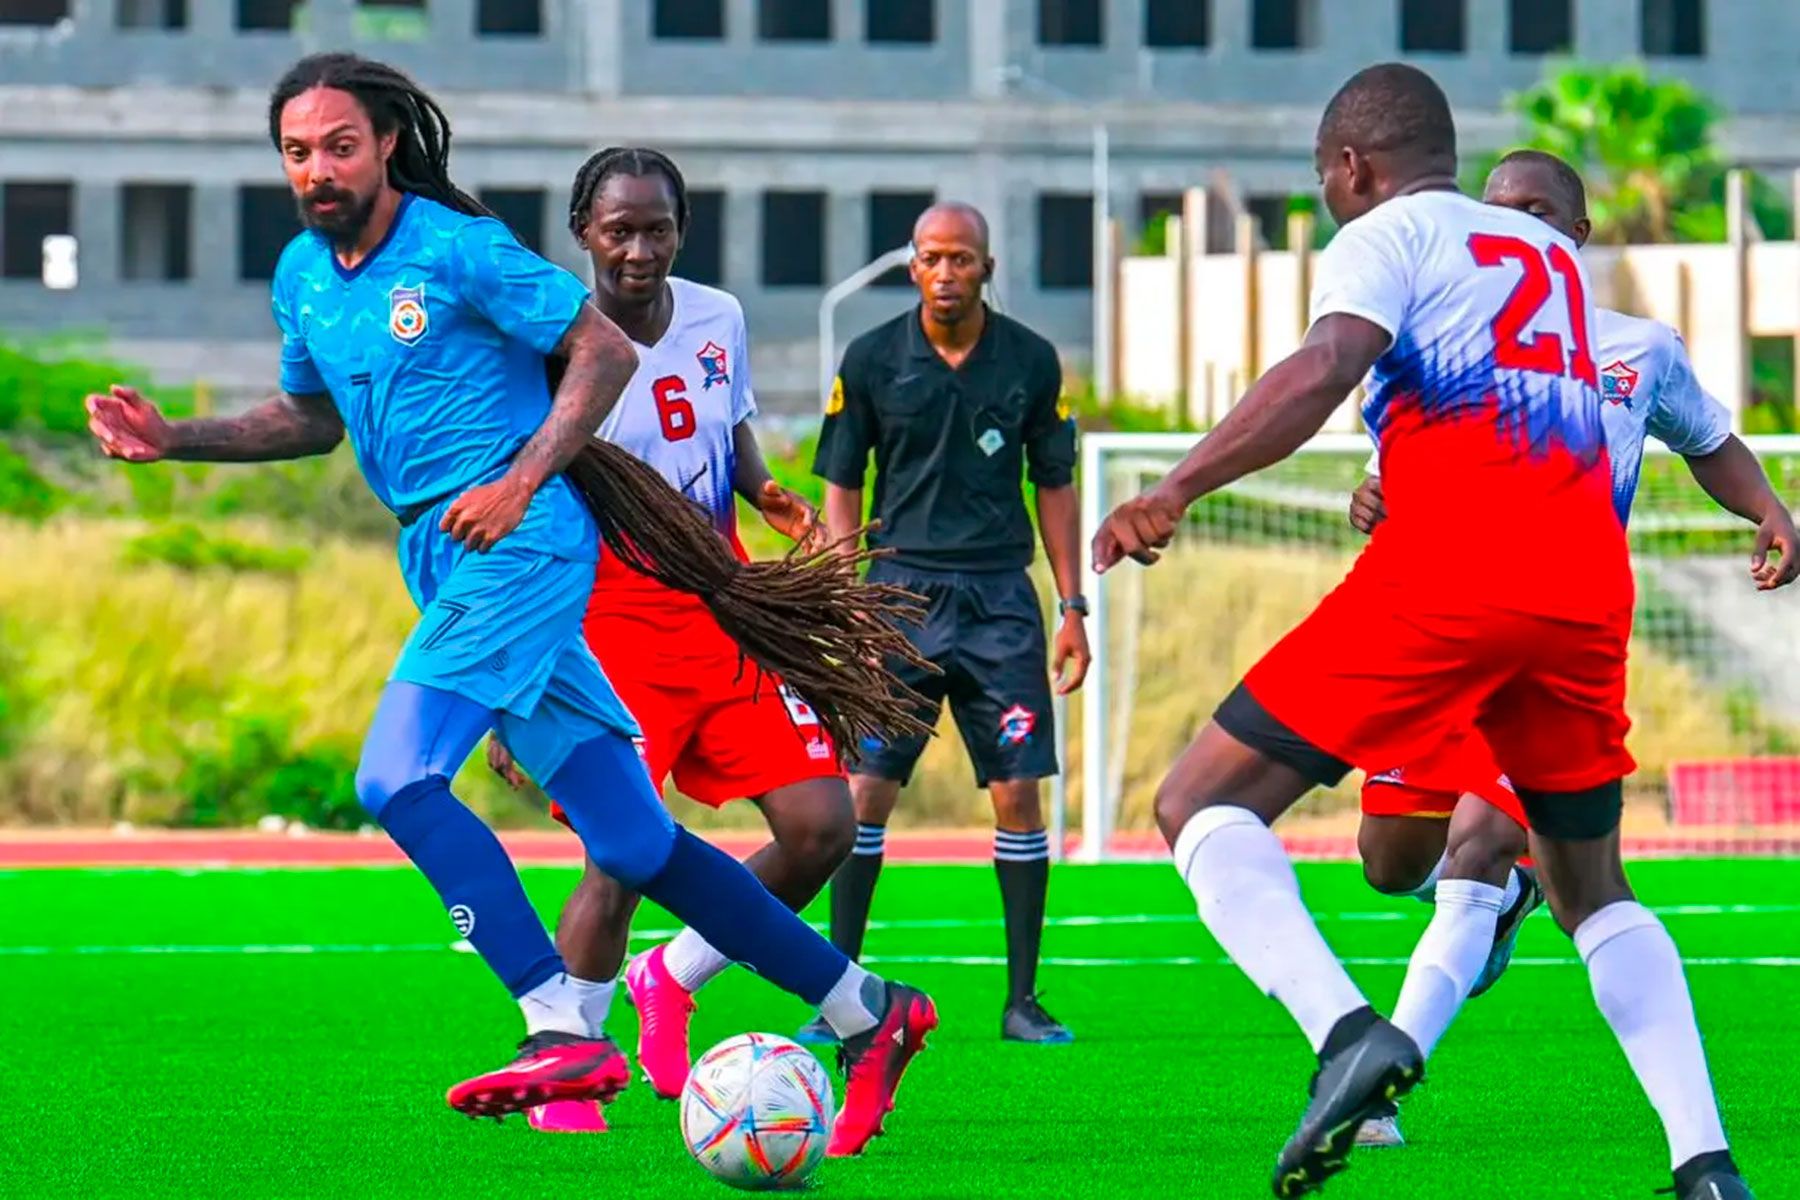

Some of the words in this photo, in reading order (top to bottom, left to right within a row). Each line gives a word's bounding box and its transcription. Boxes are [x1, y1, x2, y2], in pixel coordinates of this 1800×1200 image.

[1465, 232, 1598, 391] 21
[651, 374, 697, 443] 6
[419, 599, 471, 651] 7
